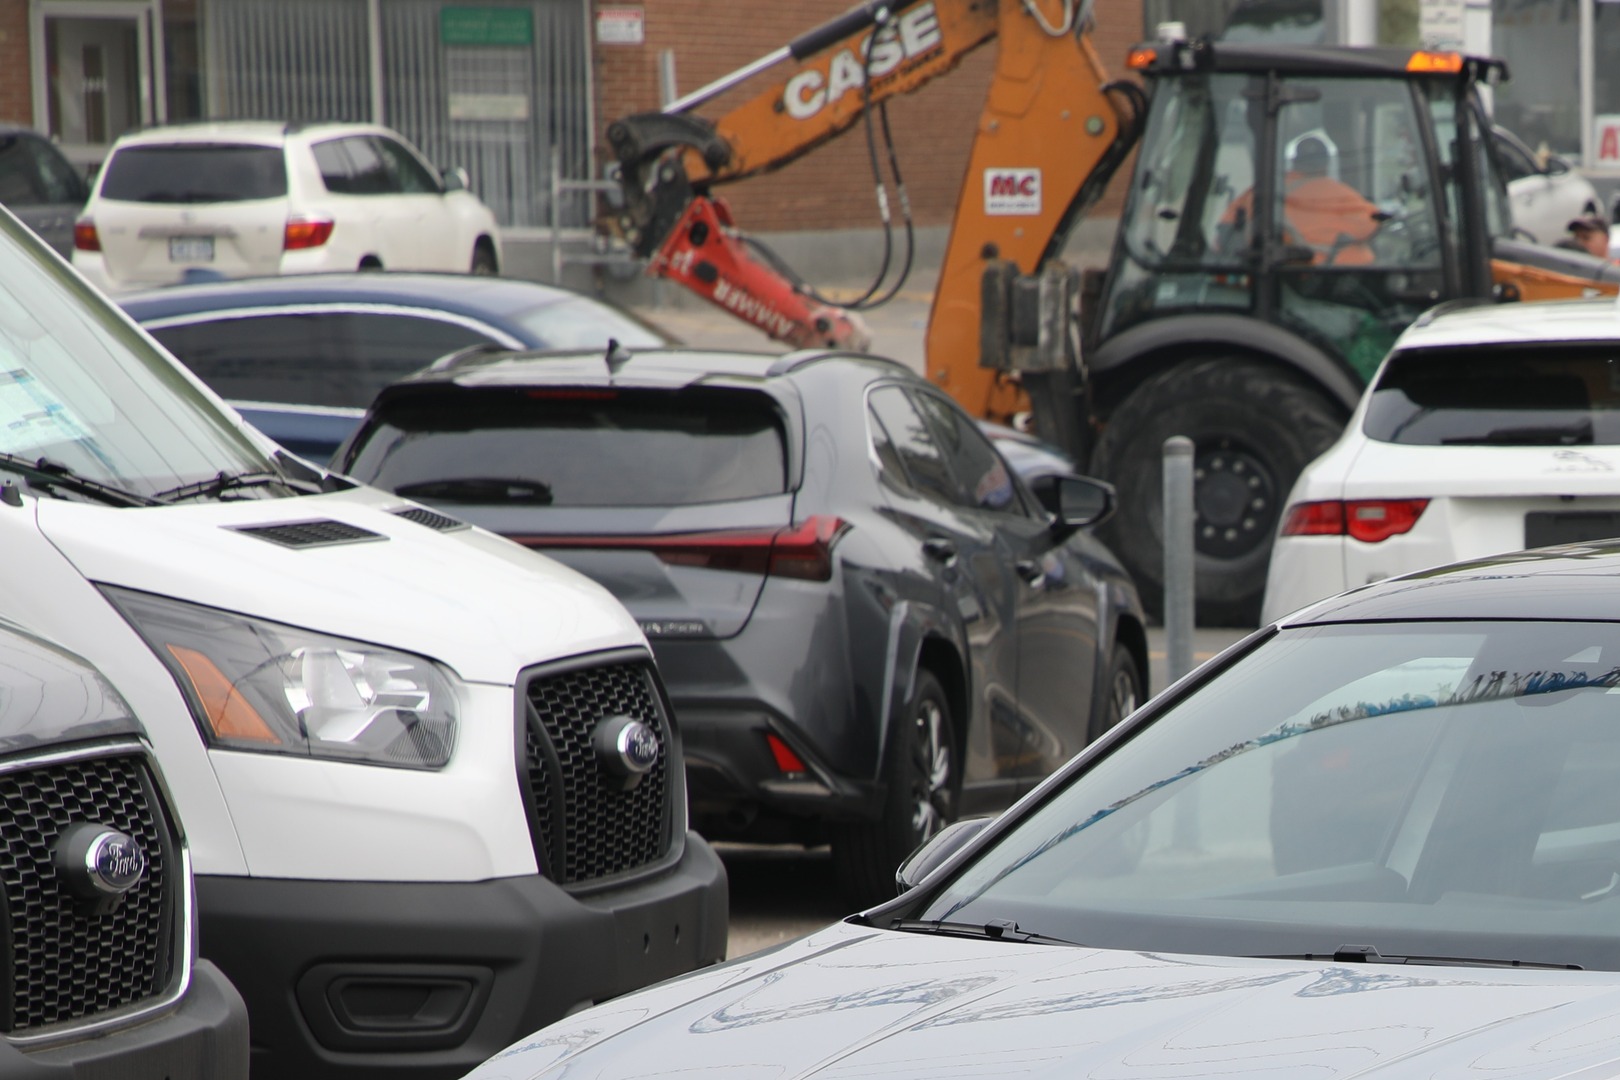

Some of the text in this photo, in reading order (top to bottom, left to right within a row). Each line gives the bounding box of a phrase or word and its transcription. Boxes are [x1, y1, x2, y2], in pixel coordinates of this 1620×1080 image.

[784, 2, 942, 119] CASE
[713, 275, 798, 340] AMMER
[109, 843, 138, 878] Ford
